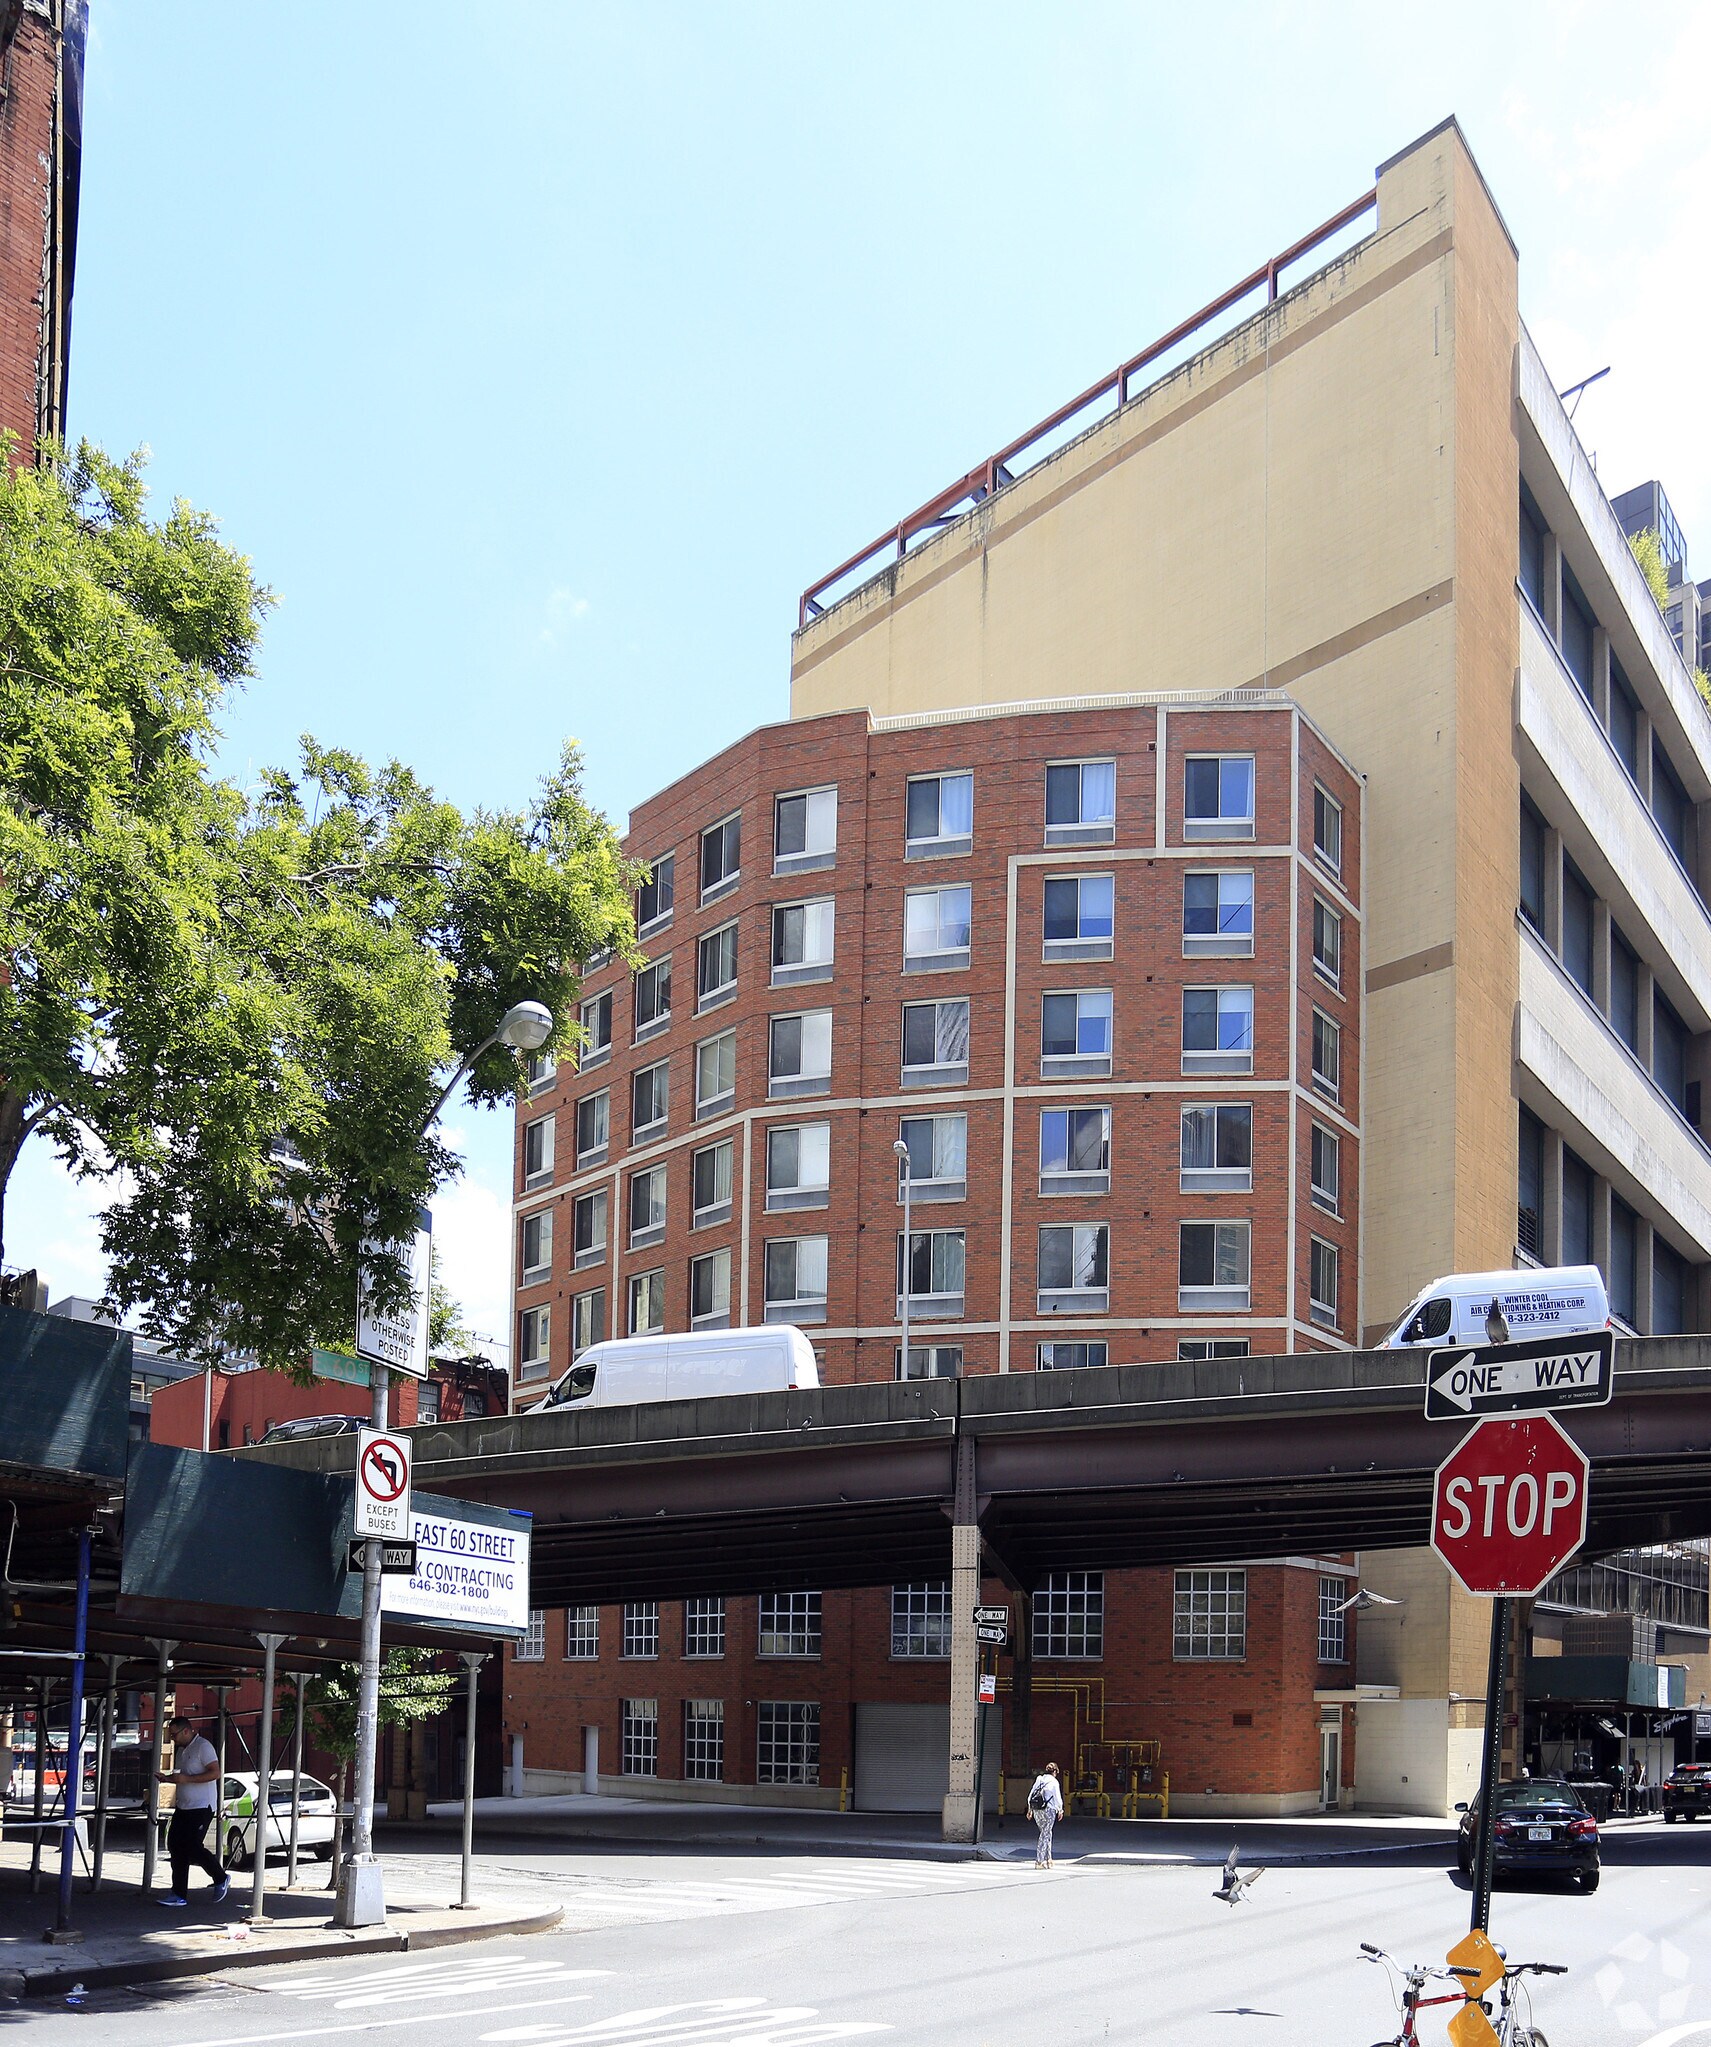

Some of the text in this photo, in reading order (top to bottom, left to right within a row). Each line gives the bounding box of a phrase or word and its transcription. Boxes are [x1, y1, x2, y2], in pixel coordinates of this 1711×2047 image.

[1470, 1299, 1585, 1314] AIR COITIONING & HEATING CORP.
[1504, 1293, 1549, 1304] WINTER COOL
[1505, 1311, 1560, 1323] 8-323-2412
[371, 1320, 416, 1349] OTHERWISE
[378, 1339, 409, 1361] POSTED
[333, 1358, 356, 1380] 60
[358, 1363, 370, 1375] ST
[1451, 1354, 1595, 1396] ONE WAY
[366, 1503, 399, 1518] EXCEPT
[1442, 1471, 1577, 1539] STOP
[368, 1518, 397, 1532] BUSES
[414, 1521, 515, 1558] EAST 60 STREET
[386, 1550, 408, 1564] WAY
[426, 1561, 514, 1591] CONTRACTING
[409, 1577, 490, 1600] 646-302-1800
